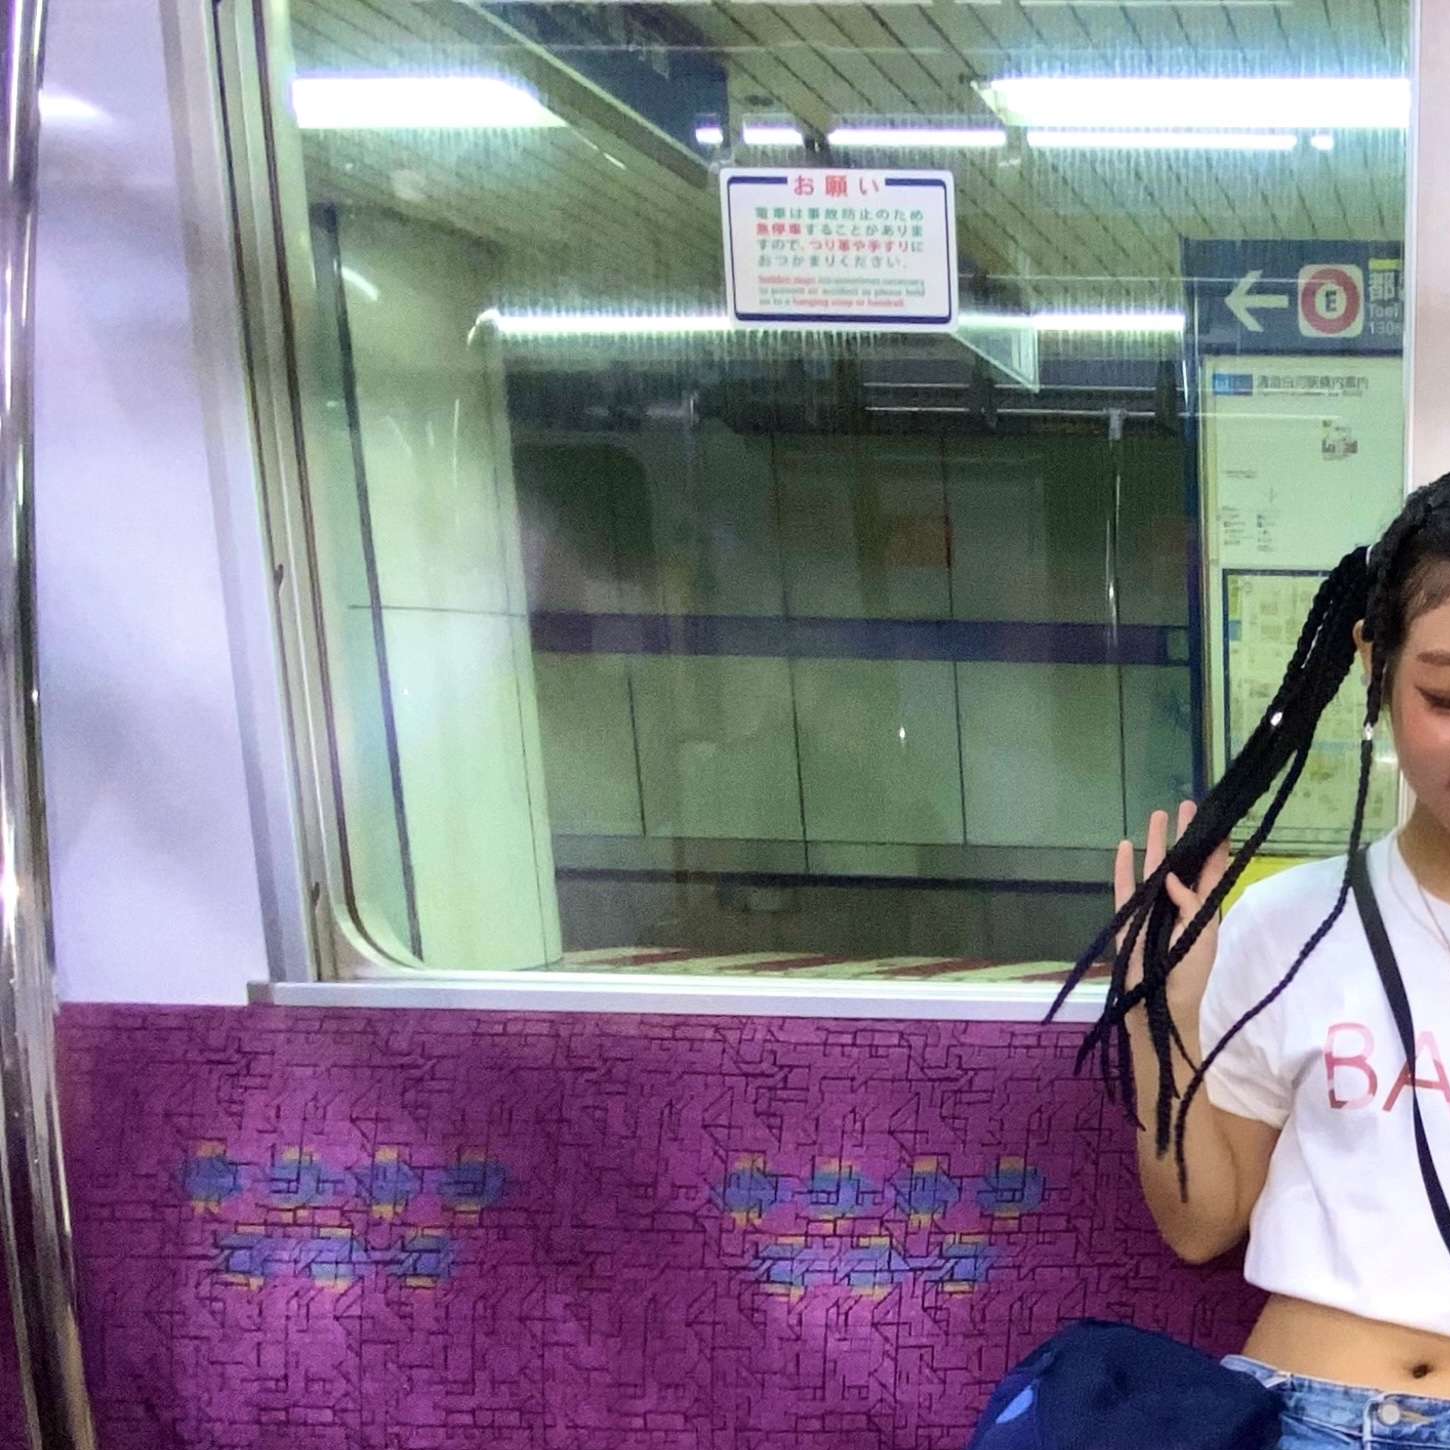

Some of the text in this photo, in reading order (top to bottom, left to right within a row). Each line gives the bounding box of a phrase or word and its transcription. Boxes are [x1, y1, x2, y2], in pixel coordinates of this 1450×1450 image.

[794, 174, 880, 197] お願い
[1325, 289, 1337, 313] E
